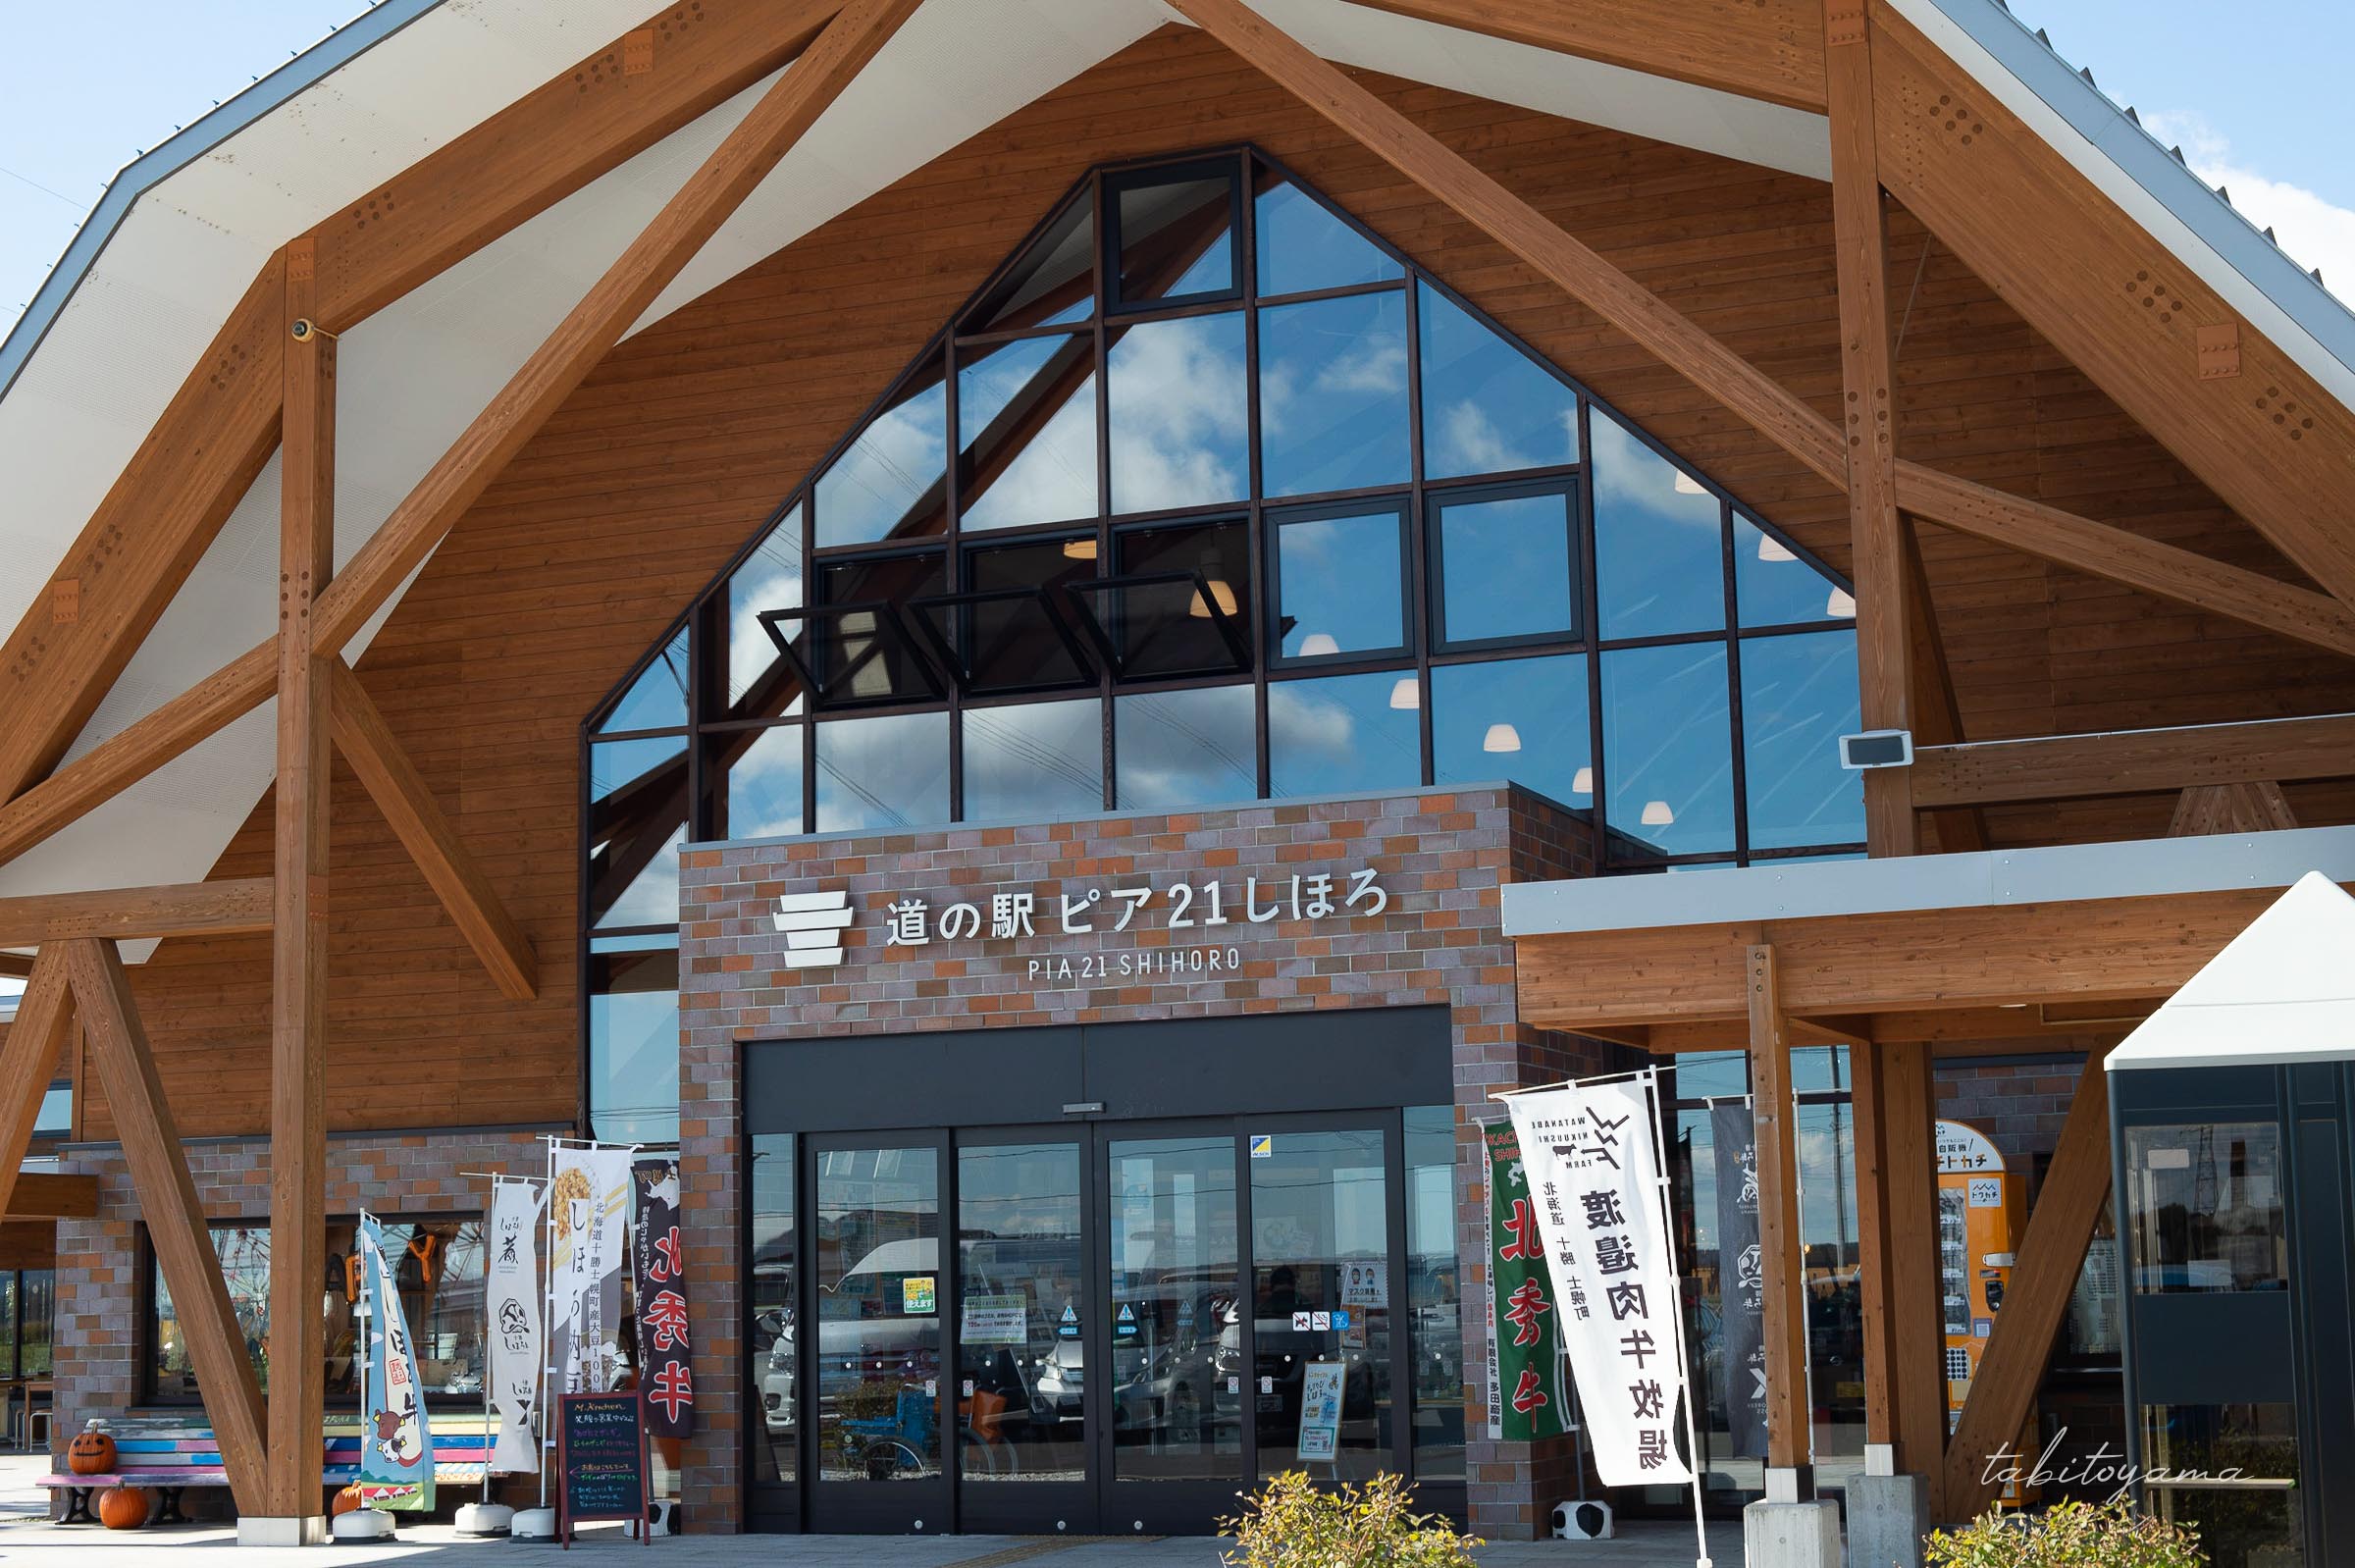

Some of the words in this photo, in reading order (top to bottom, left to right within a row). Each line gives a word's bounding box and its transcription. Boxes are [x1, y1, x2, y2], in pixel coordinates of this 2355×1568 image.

[886, 892, 1036, 946] 道の駅
[1060, 868, 1388, 934] ピア21しほろ
[1028, 957, 1073, 981] PIA
[1081, 956, 1108, 978] 21
[1120, 948, 1239, 976] SHIHORO
[1499, 1194, 1552, 1433] 北秀牛
